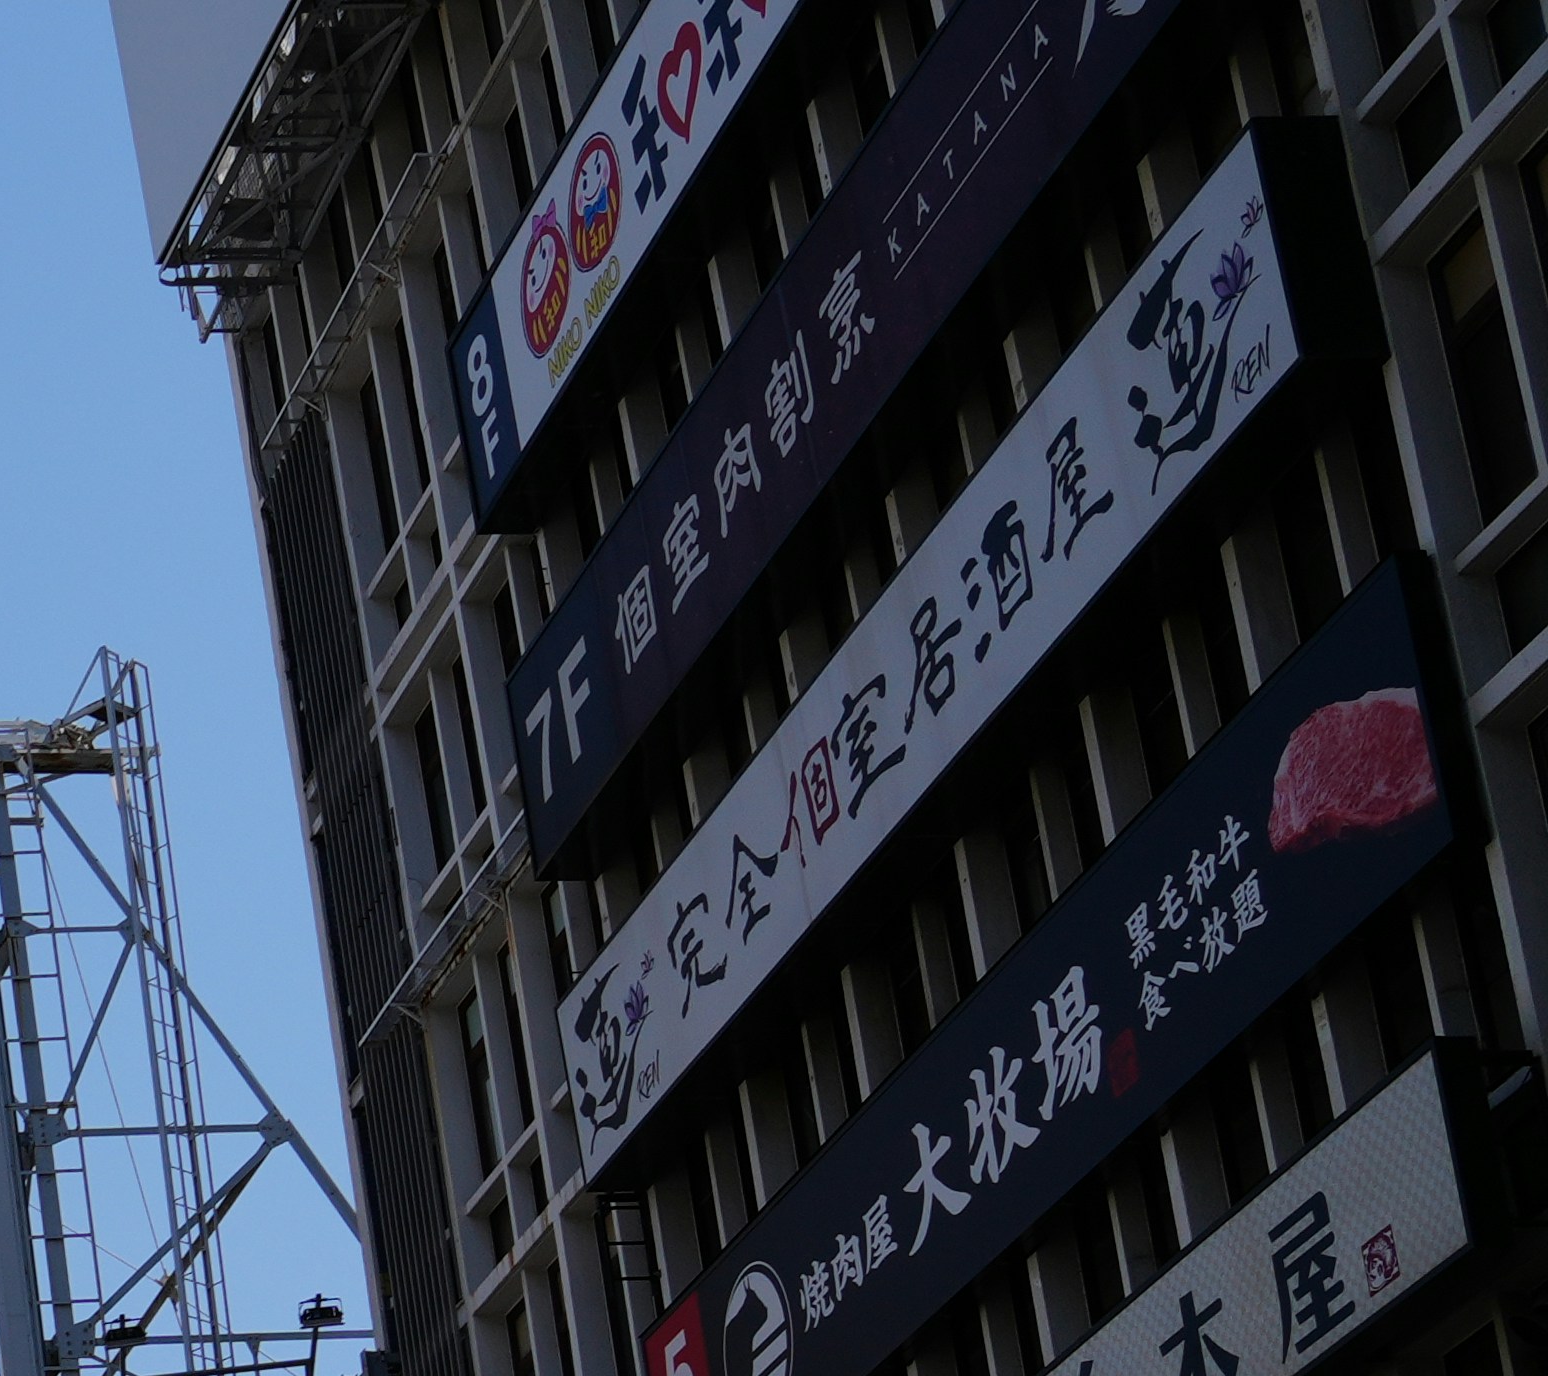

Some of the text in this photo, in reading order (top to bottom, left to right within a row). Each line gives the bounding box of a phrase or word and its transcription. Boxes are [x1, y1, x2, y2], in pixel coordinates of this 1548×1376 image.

[546, 256, 621, 387] NIKO NIKO
[1231, 324, 1272, 403] REN
[466, 333, 503, 479] 8F
[523, 23, 1049, 804] 7F 個室肉割烹 KATANA
[669, 415, 1115, 1018] 完全個室居酒屋
[1123, 813, 1251, 960] 黒毛和牛
[1140, 868, 1267, 1033] 食べ放題
[638, 1048, 660, 1104] REN
[799, 965, 1103, 1334] 焼肉屋 大牧場
